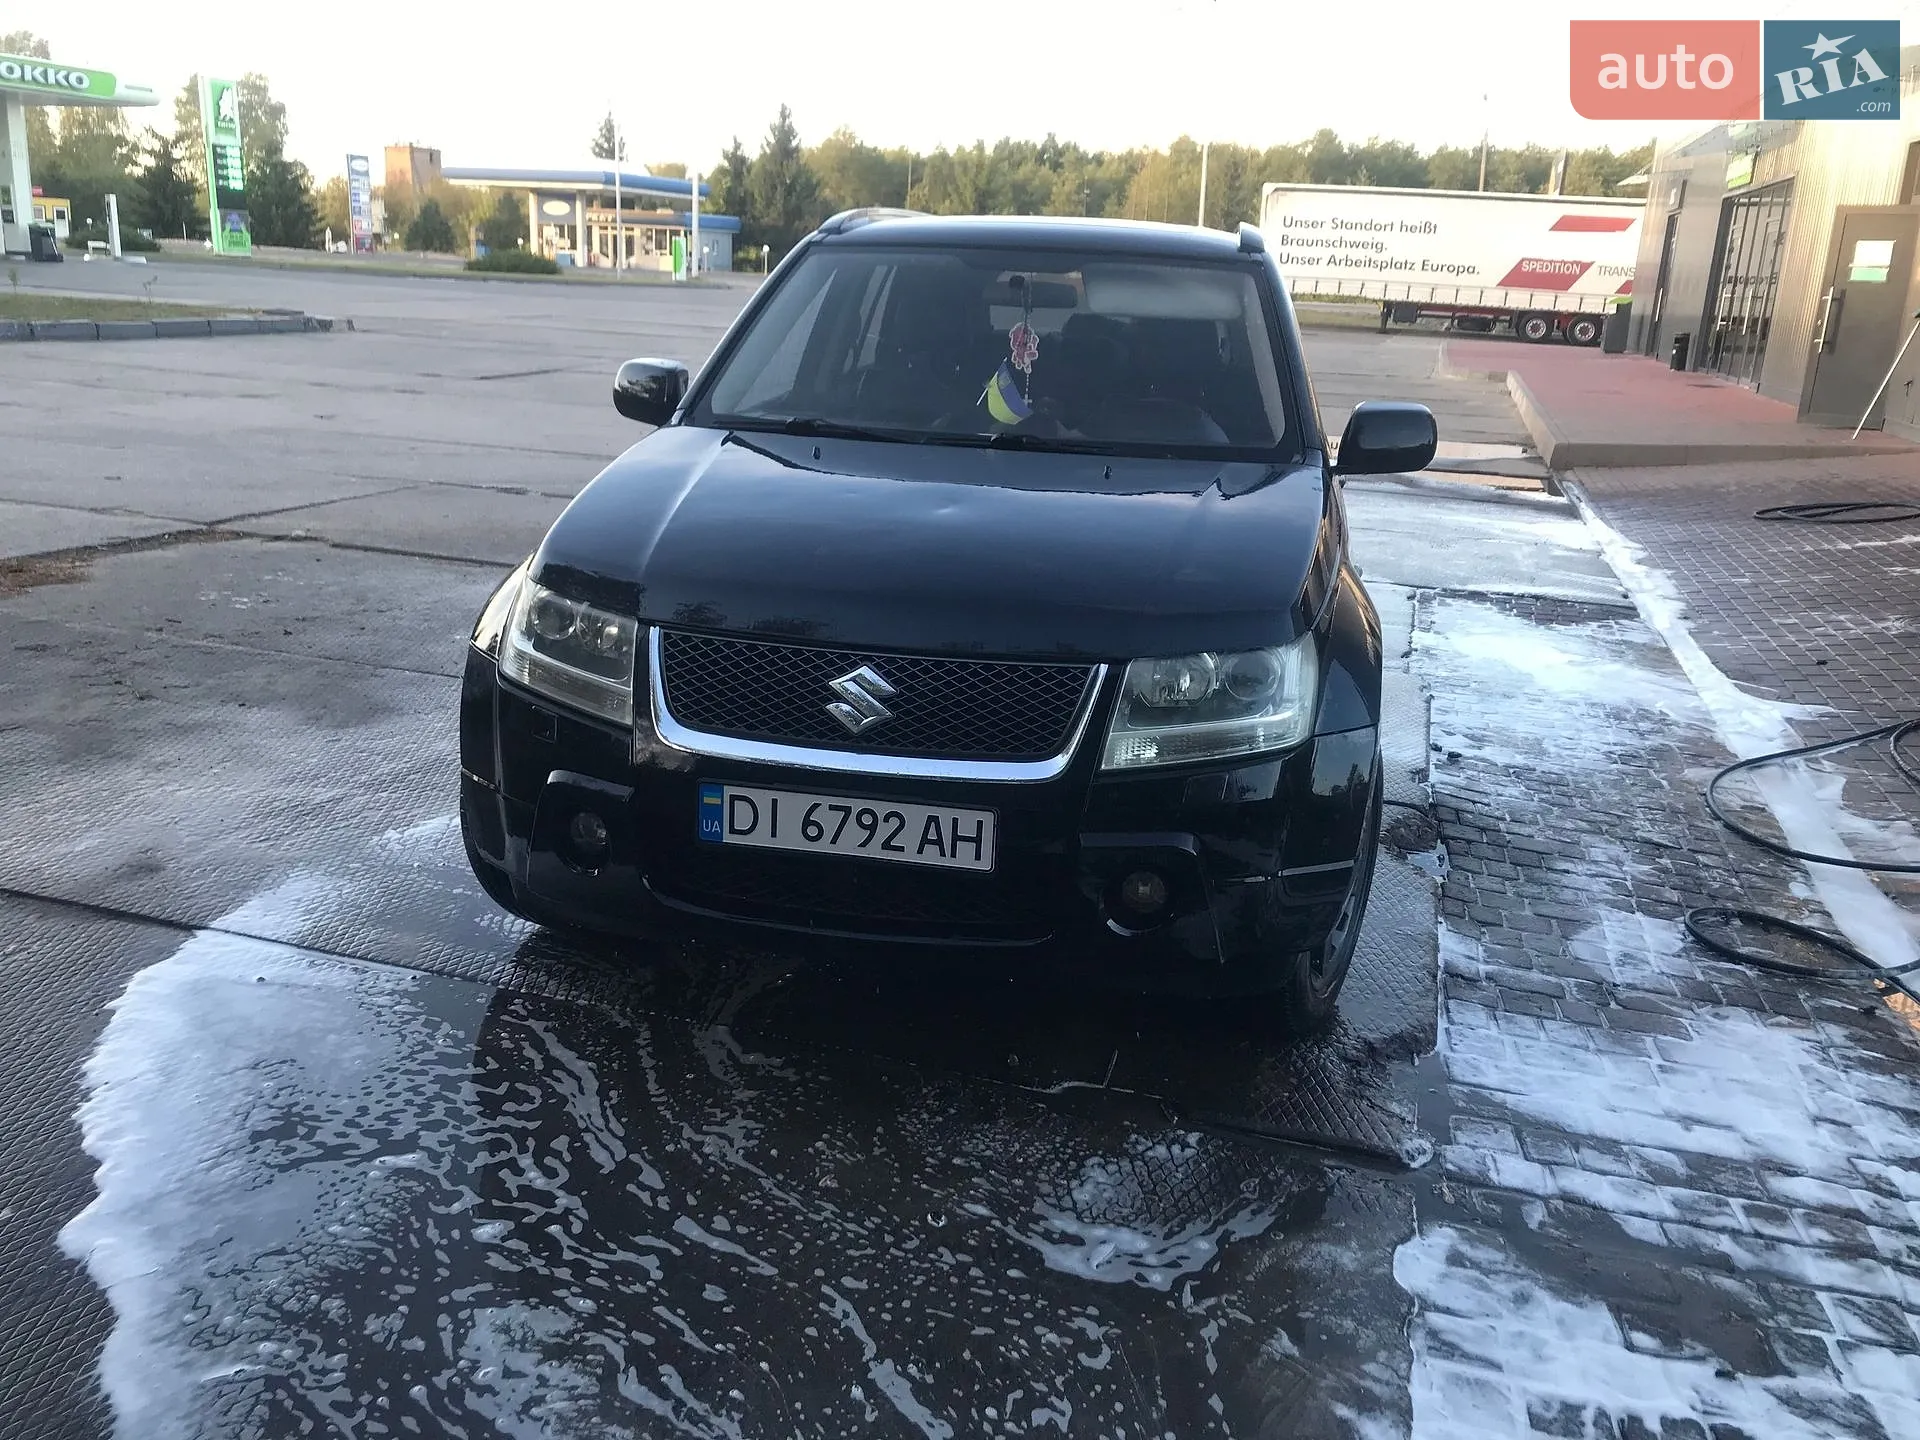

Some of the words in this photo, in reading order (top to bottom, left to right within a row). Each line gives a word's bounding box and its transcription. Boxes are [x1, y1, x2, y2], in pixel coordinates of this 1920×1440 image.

[0, 61, 90, 89] OKKO
[1283, 215, 1326, 229] Unser
[1331, 216, 1394, 232] Standort
[1400, 219, 1438, 235] heißt
[1281, 234, 1388, 254] Braunschweig.
[1279, 252, 1323, 266] Unser
[1326, 253, 1416, 273] Arbeitsplatz
[1421, 258, 1481, 277] Europa.
[1521, 260, 1581, 275] SPEDITION
[702, 819, 722, 833] UA
[728, 793, 779, 838] DI
[801, 801, 907, 853] 6792
[916, 814, 985, 861] AH
